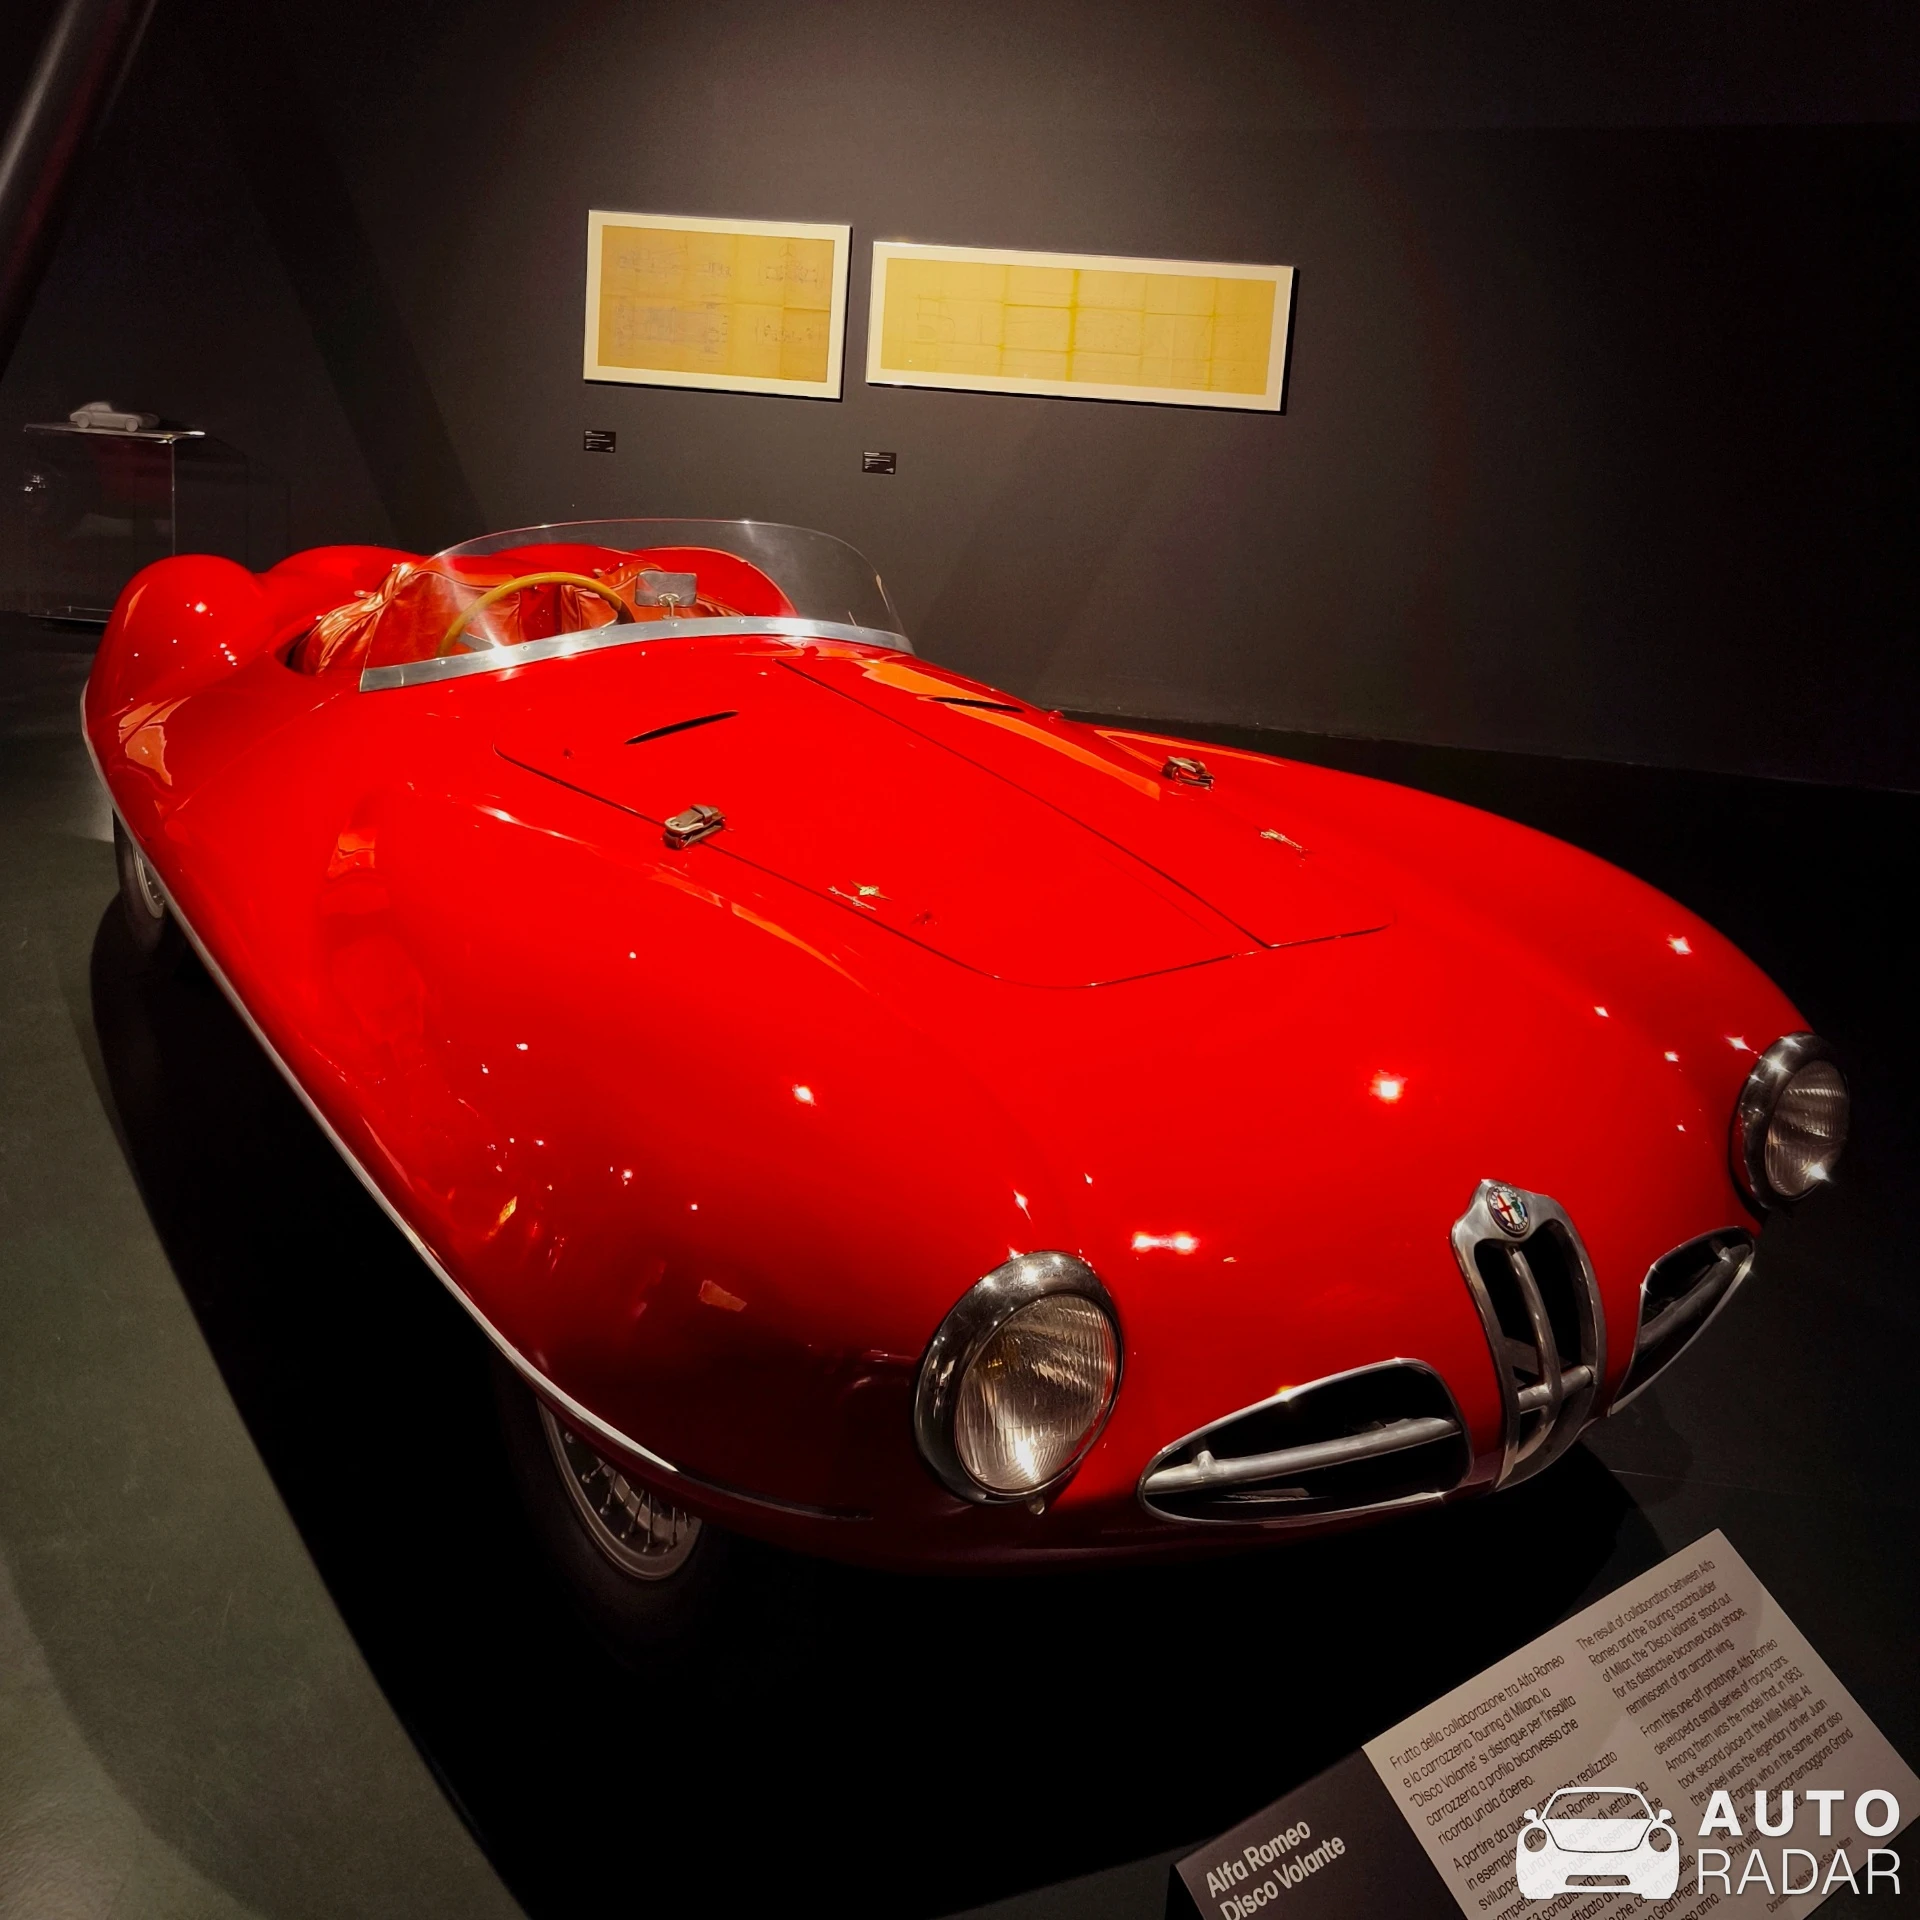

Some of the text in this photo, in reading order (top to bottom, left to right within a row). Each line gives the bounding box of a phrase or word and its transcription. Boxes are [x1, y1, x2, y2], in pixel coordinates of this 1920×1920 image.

[1577, 1560, 1714, 1649] The result of collaboration between Alfa
[1589, 1581, 1717, 1665] Romeo and the Touring coachbuilder
[1602, 1669, 1612, 1681] of
[1610, 1658, 1636, 1675] Milan,
[1632, 1648, 1647, 1661] the
[1698, 1599, 1719, 1618] stood
[1718, 1592, 1731, 1605] out
[1613, 1686, 1627, 1698] for
[1624, 1679, 1637, 1690] its
[1635, 1654, 1675, 1683] distinctive
[1672, 1634, 1706, 1658] biconvex
[1703, 1622, 1724, 1637] body
[1626, 1679, 1671, 1714] reminiscent
[1670, 1673, 1680, 1685] of
[1678, 1668, 1689, 1679] an
[1688, 1648, 1716, 1672] aircraft
[1640, 1718, 1663, 1737] From
[1660, 1708, 1678, 1723] this
[1677, 1687, 1705, 1712] one-off
[1737, 1656, 1754, 1669] Alfa
[1750, 1639, 1777, 1660] Romeo
[1390, 1655, 1564, 1768] Frutto della collaborazione tra Alfa Romeo
[1403, 1687, 1551, 1787] e la carrozzeria Touring di Milano, la
[1479, 1750, 1489, 1763] si
[1486, 1727, 1528, 1757] distingue
[1527, 1717, 1543, 1734] per
[1653, 1720, 1694, 1753] developed
[1693, 1718, 1700, 1726] a
[1699, 1701, 1720, 1721] small
[1719, 1688, 1742, 1708] series
[1741, 1680, 1750, 1692] of
[1749, 1667, 1773, 1686] racing
[1664, 1747, 1696, 1771] Among
[1691, 1733, 1713, 1751] them
[1712, 1721, 1729, 1737] was
[1726, 1712, 1742, 1726] the
[1740, 1694, 1764, 1716] model
[1776, 1680, 1786, 1689] in
[1677, 1768, 1697, 1788] took
[1696, 1748, 1725, 1775] second
[1724, 1735, 1745, 1756] place
[1744, 1727, 1754, 1739] at
[1751, 1720, 1766, 1733] the
[1763, 1708, 1782, 1724] Mille
[1800, 1685, 1812, 1696] At
[1690, 1700, 1827, 1805] the wheel was the legendary driver Juan
[1758, 1764, 1774, 1780] who
[1771, 1759, 1781, 1768] in
[1779, 1750, 1793, 1762] the
[1792, 1735, 1812, 1753] same
[1811, 1723, 1828, 1741] year
[1827, 1712, 1842, 1727] also
[1426, 1719, 1579, 1825] carrozzeria a profilo biconvesso che
[1452, 1857, 1462, 1870] A
[1462, 1838, 1494, 1866] partire
[1492, 1828, 1507, 1842] da
[1507, 1806, 1539, 1835] queso
[1577, 1752, 1617, 1784] realizzato
[1644, 1797, 1662, 1813] he
[1716, 1820, 1734, 1839] wa
[1730, 1812, 1747, 1827] he
[1829, 1727, 1853, 1749] Grand
[1206, 1821, 1311, 1898] Alfa Romeo
[1438, 1816, 1473, 1844] ricorda
[1464, 1877, 1477, 1889] in
[1524, 1822, 1551, 1847] unic
[1567, 1790, 1599, 1816] Romeo
[1727, 1842, 1745, 1858] Prix
[1219, 1837, 1346, 1920] Disco Volante
[1653, 1898, 1676, 1919] Gran
[1698, 1896, 1720, 1914] anno.
